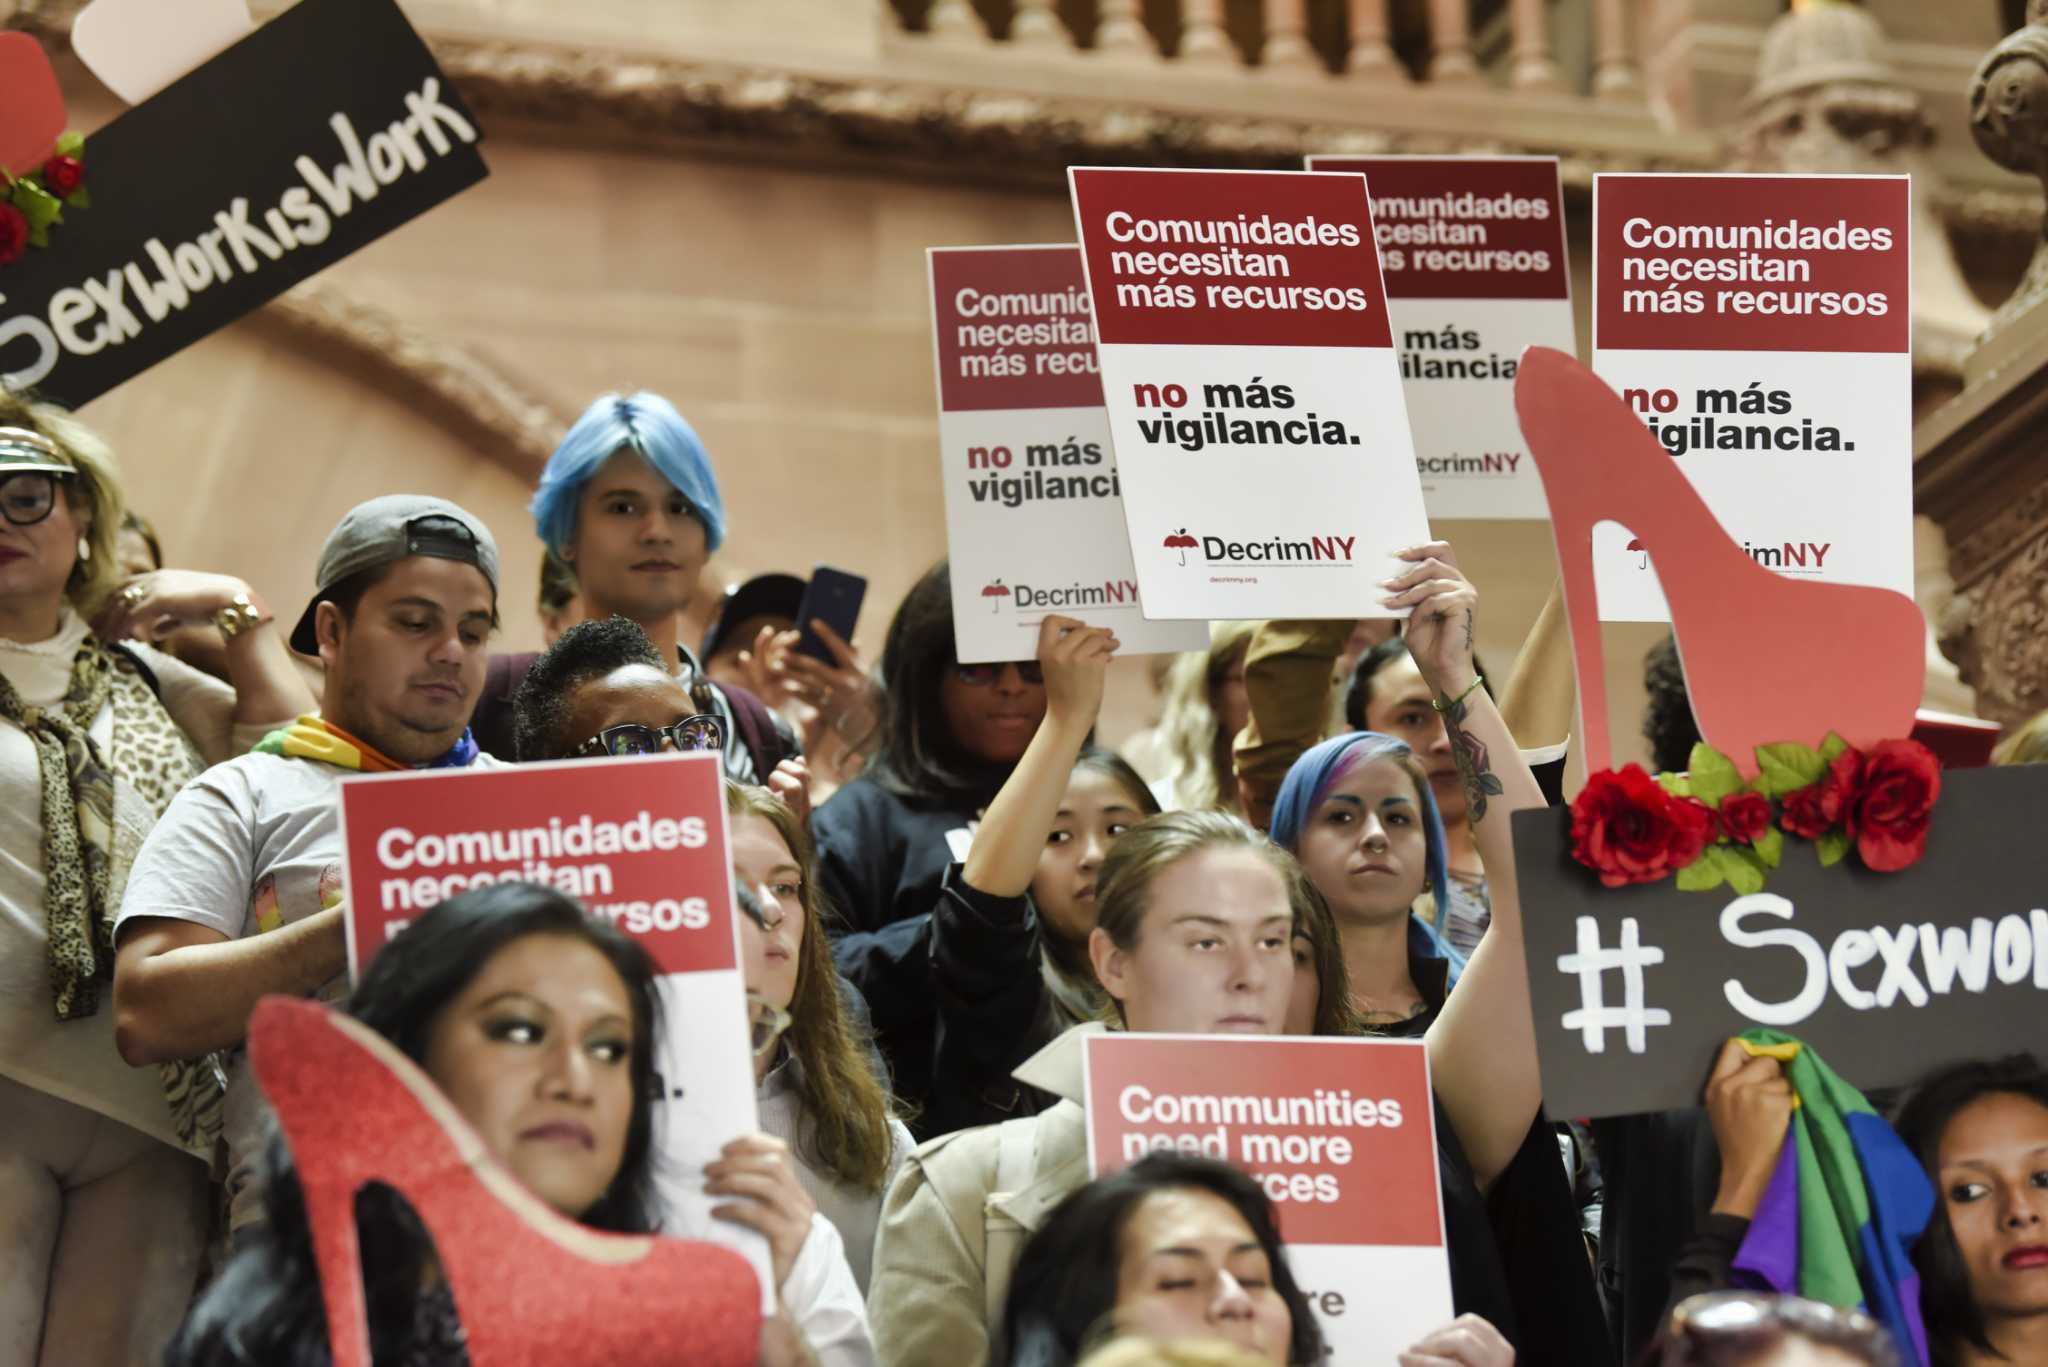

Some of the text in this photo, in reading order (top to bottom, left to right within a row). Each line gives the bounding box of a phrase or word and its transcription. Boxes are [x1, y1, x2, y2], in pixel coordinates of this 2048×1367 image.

[1370, 192, 1550, 220] munidades
[1105, 211, 1361, 247] Comunidades
[1375, 218, 1487, 245] cesitan
[1622, 217, 1893, 251] Comunidades
[1111, 246, 1290, 276] necesitan
[1413, 251, 1550, 272] recursos
[1623, 252, 1810, 282] necesitan
[1116, 277, 1368, 311] más recursos
[1623, 283, 1889, 316] más recursos
[1404, 324, 1481, 351] más
[960, 348, 1027, 377] más
[1402, 354, 1519, 379] ilancia
[1133, 376, 1295, 409] no más
[1623, 382, 1792, 415] no más
[1137, 411, 1361, 452] vigilancia.
[1648, 416, 1856, 457] igilancia.
[967, 436, 1102, 469] no más
[1416, 452, 1521, 474] ecrimNY
[1202, 536, 1356, 561] DecrimNY
[1014, 580, 1138, 607] DecrimNY
[376, 811, 708, 870] Comunidades
[1119, 1085, 1402, 1127] Communities
[1241, 1133, 1353, 1165] more
